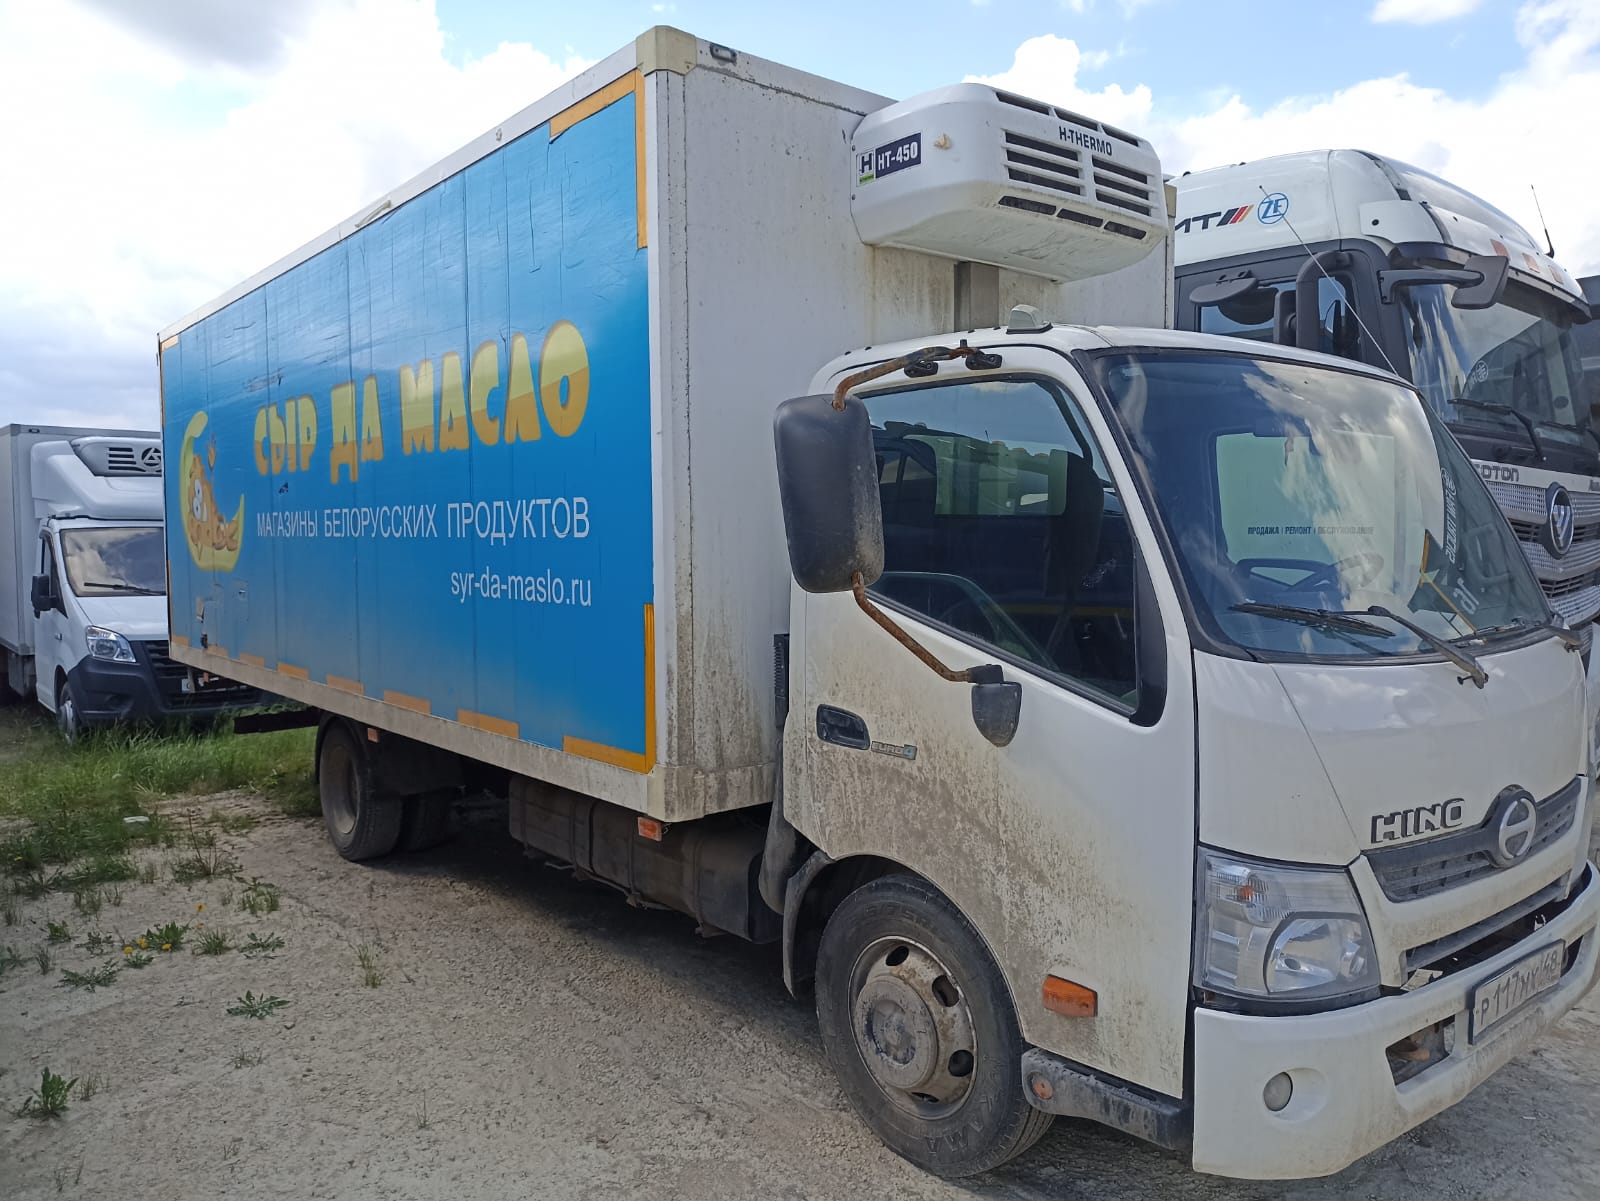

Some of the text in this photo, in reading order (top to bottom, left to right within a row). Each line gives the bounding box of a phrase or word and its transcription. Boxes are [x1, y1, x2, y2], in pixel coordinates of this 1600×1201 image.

[878, 141, 918, 171] HT-450
[1059, 126, 1112, 156] H-THERMO
[254, 319, 590, 484] СЫР ДА МАСЛО
[257, 496, 590, 546] МАГАЗИНЫ БЕЛОРУССКИХ ПРОДУКТОВ
[1247, 526, 1280, 536] ПРОДАЖА
[1285, 526, 1312, 535] РЕМОНТ
[450, 566, 592, 607] syr-da-maslo.ru
[1371, 797, 1465, 844] HINO
